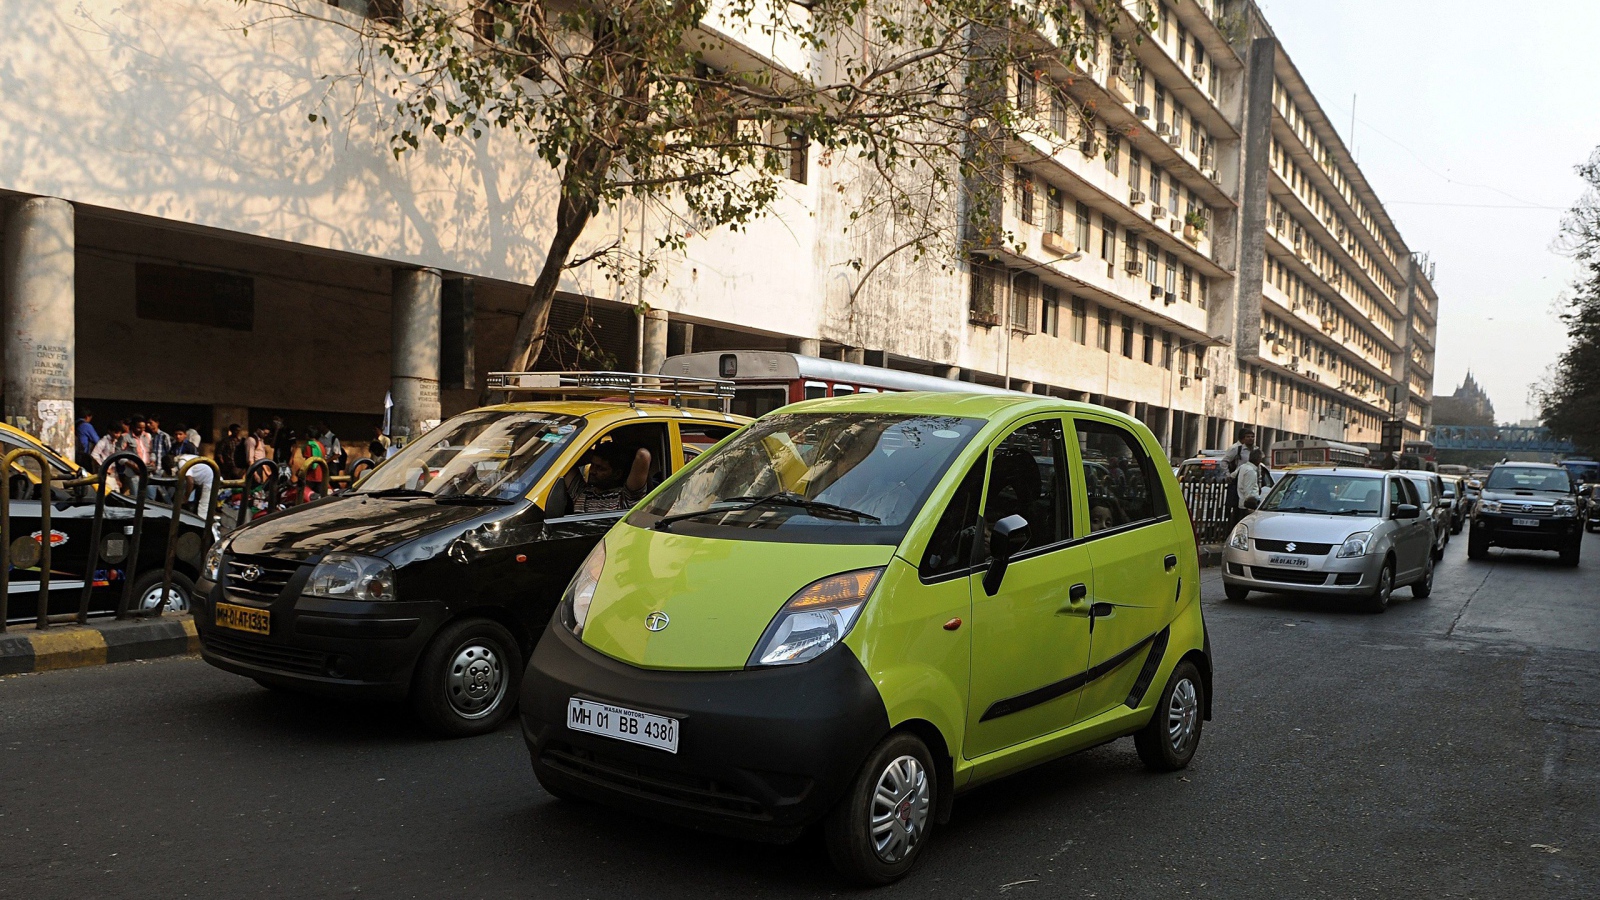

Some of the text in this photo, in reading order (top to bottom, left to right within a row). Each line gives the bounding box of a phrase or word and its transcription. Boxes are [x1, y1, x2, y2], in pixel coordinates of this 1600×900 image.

[572, 707, 674, 742] MH 01 BB 4380
[603, 706, 645, 719] WASAN MOTORS
